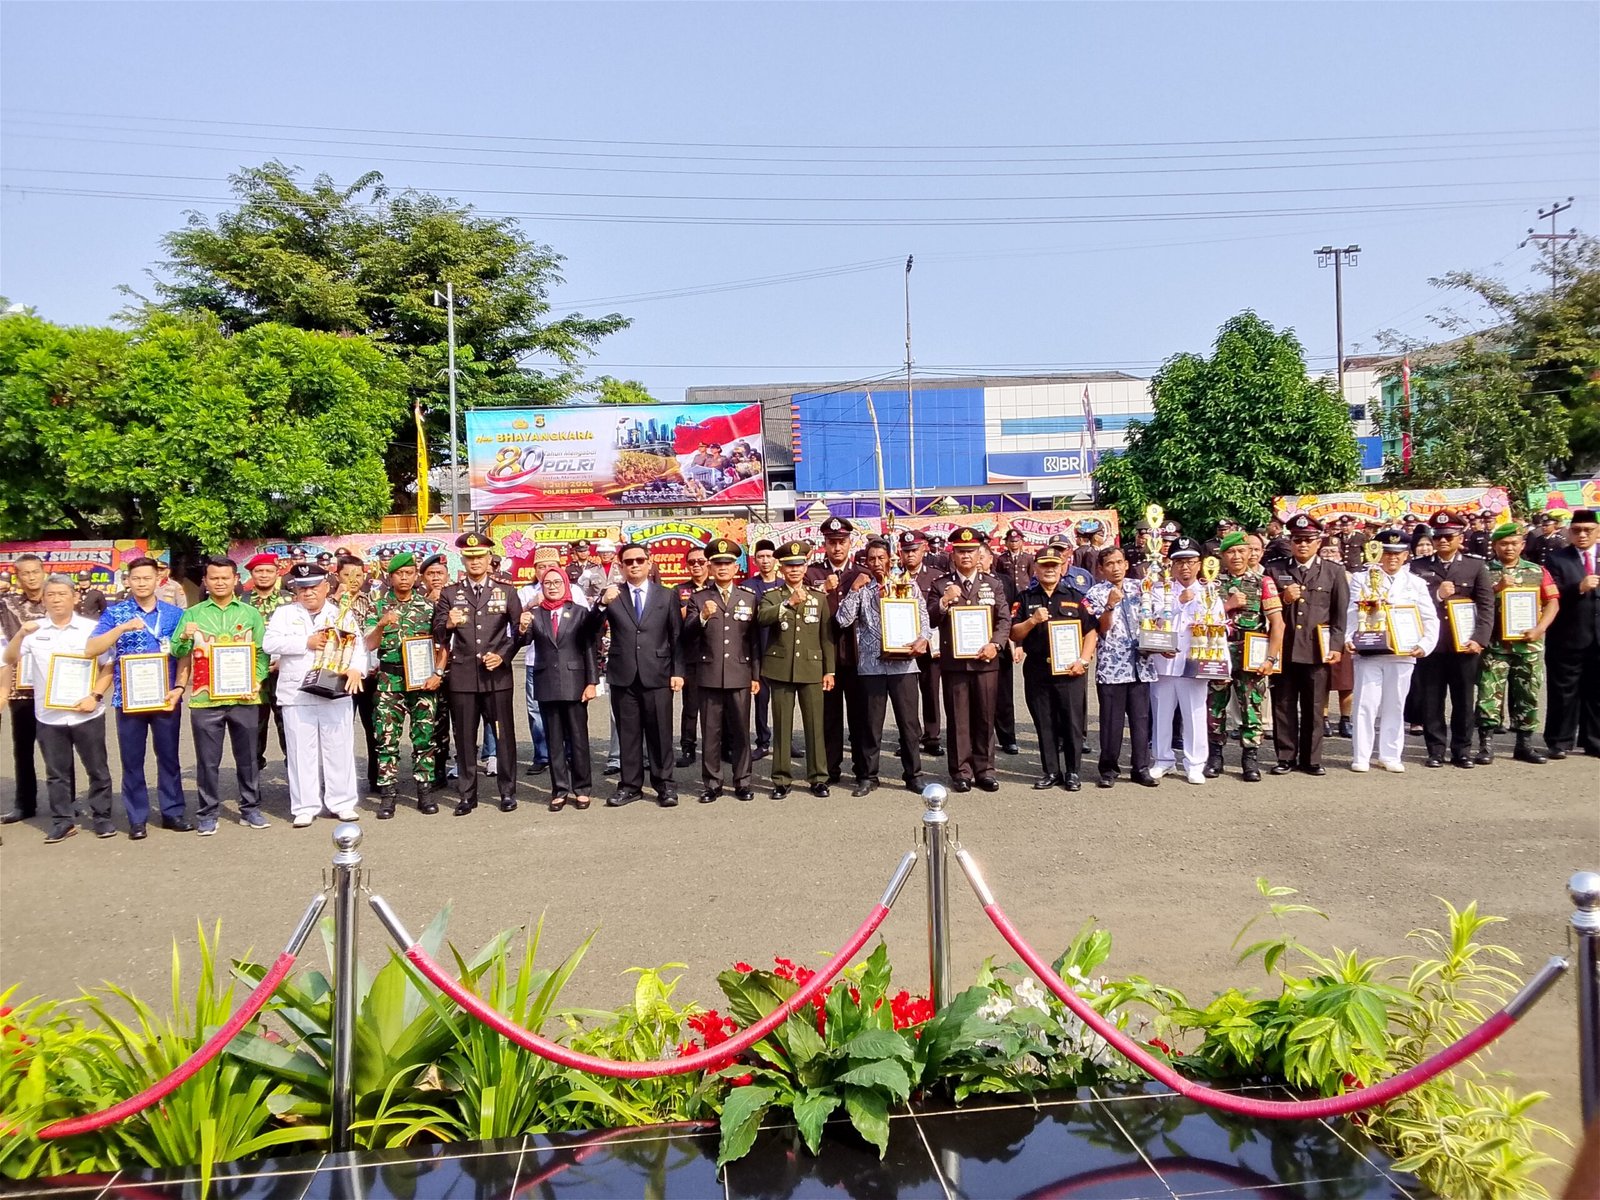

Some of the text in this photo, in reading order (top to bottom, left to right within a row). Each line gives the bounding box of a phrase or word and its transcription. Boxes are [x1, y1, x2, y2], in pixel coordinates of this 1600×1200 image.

[496, 431, 594, 442] BHAYANGKARA
[487, 445, 545, 478] 80
[542, 459, 597, 472] POLRI
[535, 523, 705, 542] SELAMAT SUKSES
[1013, 519, 1067, 535] SUKSES
[49, 550, 112, 563] SUKSES
